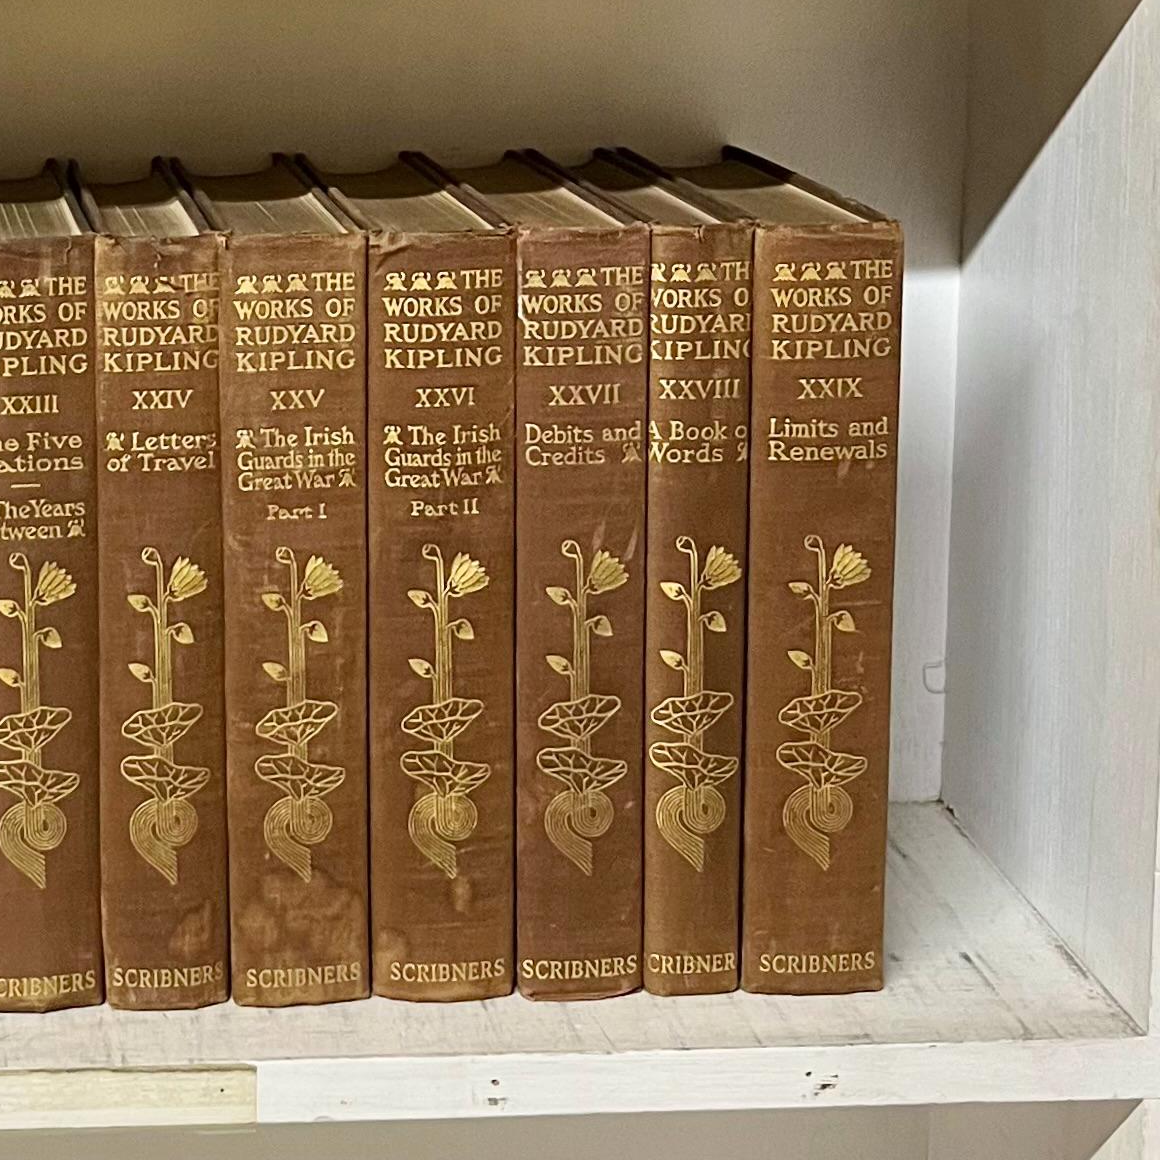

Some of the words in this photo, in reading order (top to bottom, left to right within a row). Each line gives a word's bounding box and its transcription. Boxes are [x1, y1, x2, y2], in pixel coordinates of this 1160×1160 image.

[850, 260, 892, 279] THE
[770, 287, 851, 307] WORKS
[864, 286, 892, 305] OF
[772, 312, 891, 333] RUDYARD
[770, 338, 891, 360] KIPLING
[797, 378, 863, 399] XXIX
[270, 389, 325, 410] XXV
[260, 428, 298, 448] The
[304, 426, 355, 447] Irish
[408, 425, 446, 445] The
[453, 423, 500, 444] Irish
[525, 424, 593, 444] Debits
[603, 421, 640, 441] and
[649, 419, 663, 441] A
[669, 420, 727, 442] Book
[768, 418, 838, 438] Limits
[849, 416, 888, 437] and
[27, 432, 82, 451] Five
[131, 432, 216, 451] Letters
[768, 440, 887, 461] Renewals
[107, 454, 131, 472] of
[137, 451, 214, 471] Travel
[238, 450, 303, 470] Guards
[308, 451, 325, 468] in
[328, 448, 356, 467] the
[385, 447, 452, 467] Guards
[456, 448, 472, 465] in
[475, 445, 501, 464] the
[525, 446, 605, 466] Credits
[649, 442, 723, 465] Words
[238, 472, 292, 491] Great
[291, 467, 335, 488] War
[385, 468, 440, 488] Great
[440, 467, 482, 486] War
[29, 499, 85, 518] Years
[266, 505, 312, 520] Part
[411, 501, 458, 516] Part
[463, 498, 479, 514] II
[390, 956, 504, 982] SCRIBNERS
[759, 952, 874, 973] SCRIBNERS
